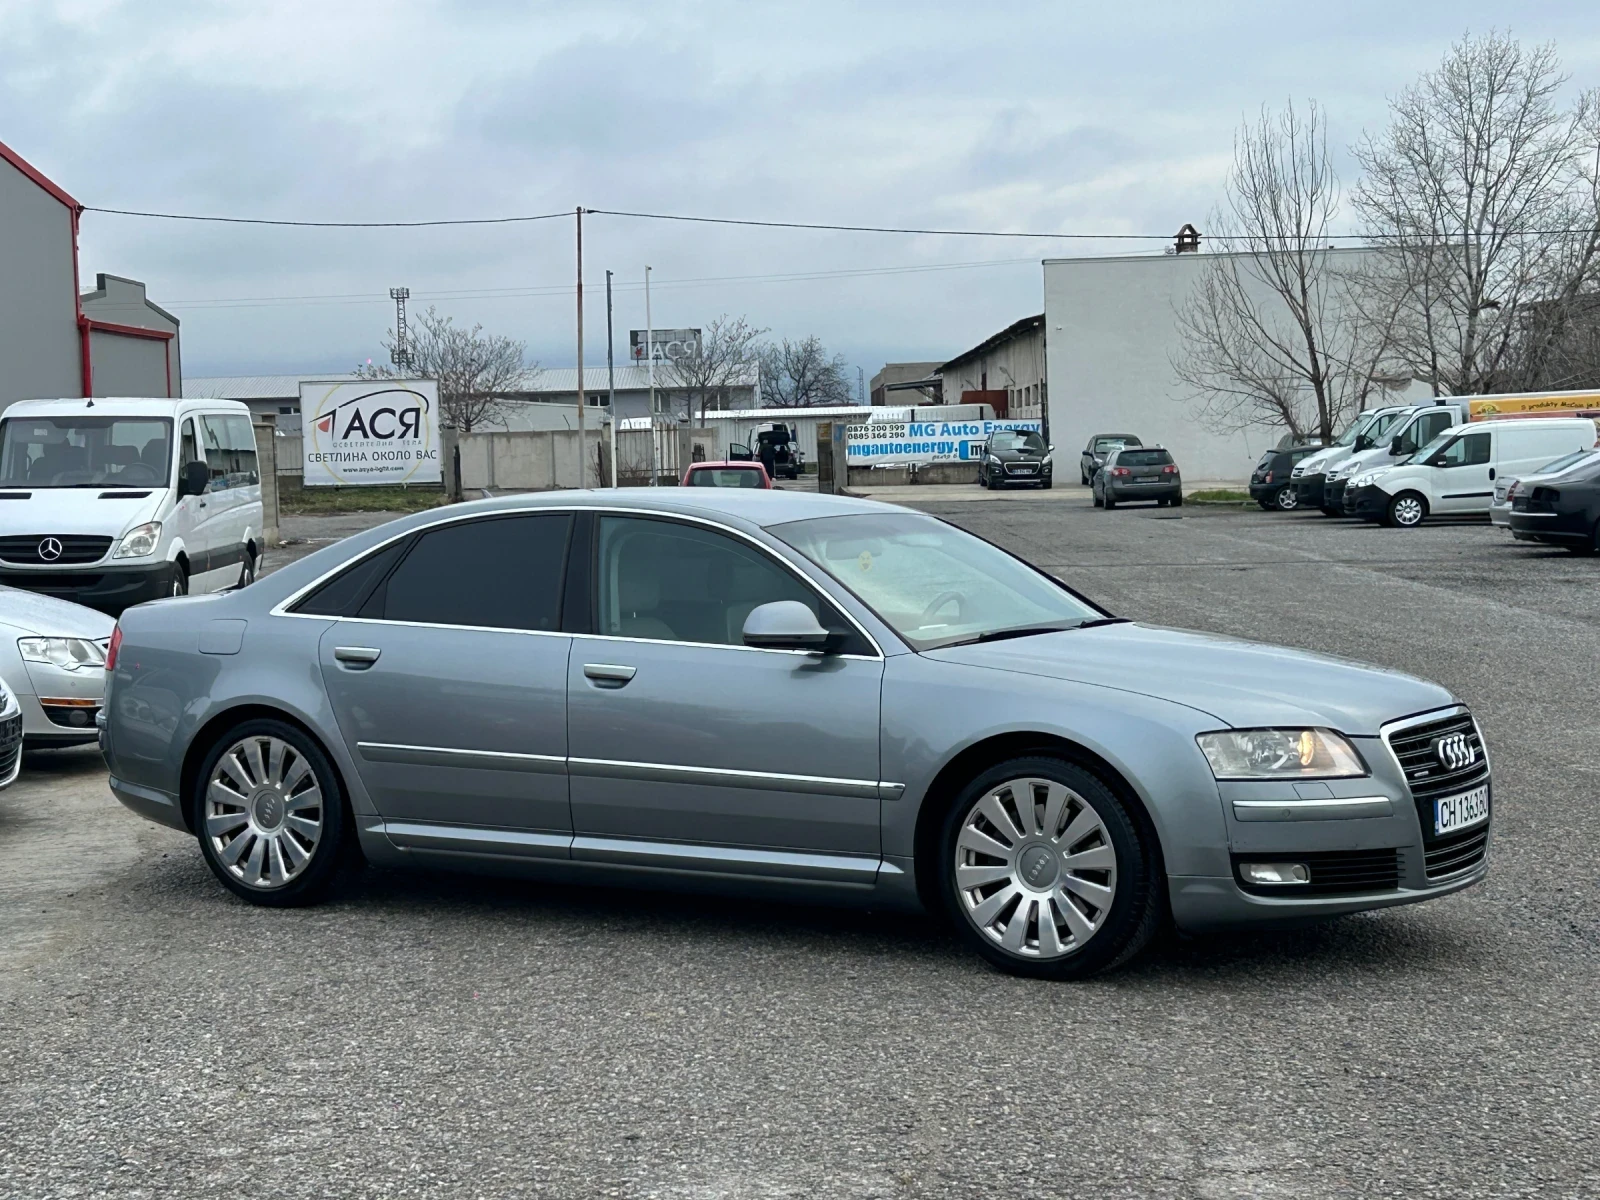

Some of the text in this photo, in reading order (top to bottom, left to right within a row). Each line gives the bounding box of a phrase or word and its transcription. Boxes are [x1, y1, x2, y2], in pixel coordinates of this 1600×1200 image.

[342, 407, 421, 440] АСЯ
[847, 425, 869, 433] 0876
[871, 424, 887, 432] 200
[909, 423, 936, 437] MG
[940, 423, 980, 436] Auto
[848, 432, 869, 440] 0885
[308, 449, 437, 463] СВЕТЛИНА ОКОЛО ВАС
